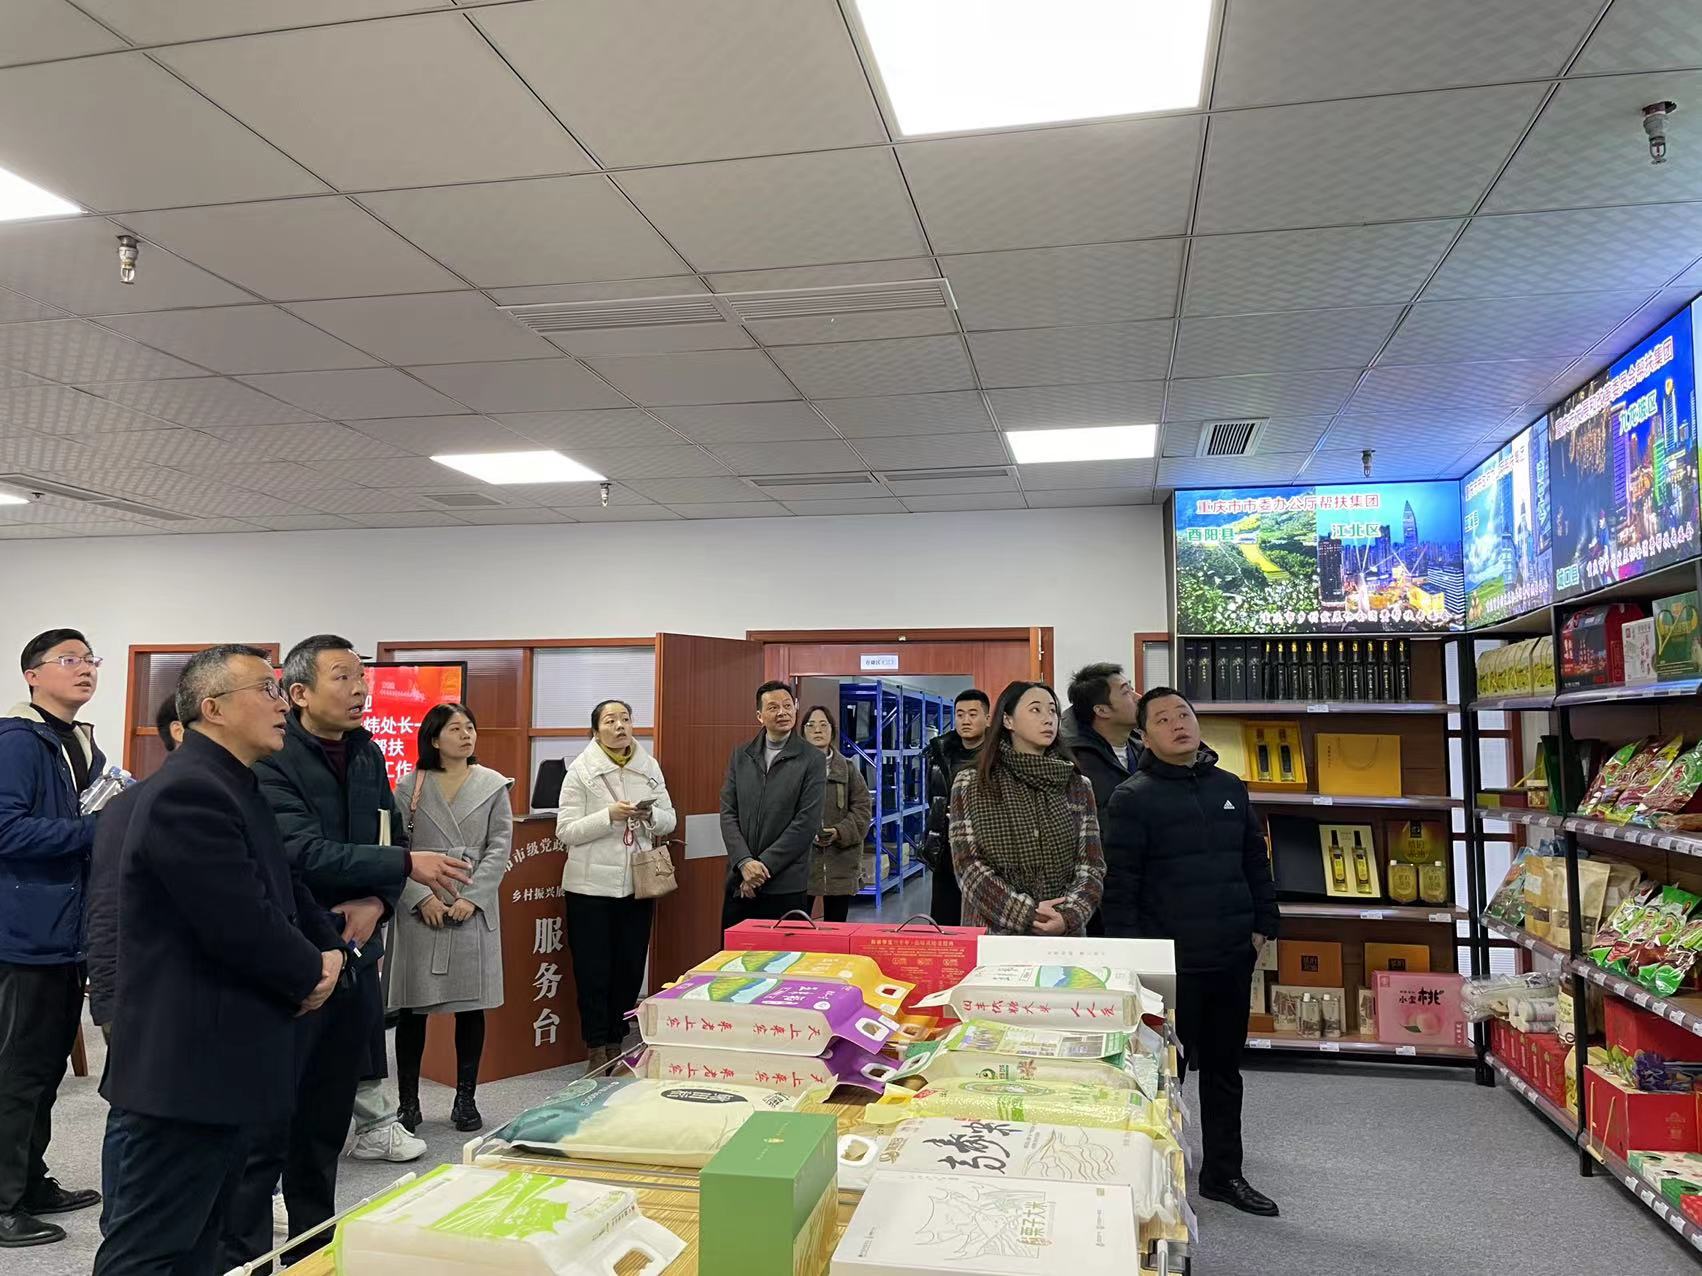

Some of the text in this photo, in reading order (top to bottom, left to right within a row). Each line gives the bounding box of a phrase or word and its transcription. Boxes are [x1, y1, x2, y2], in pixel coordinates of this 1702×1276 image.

[1197, 494, 1380, 515] 重庆市市委办公厅帮扶集团
[1187, 527, 1235, 542] 酉阳县
[1331, 523, 1381, 538] 江北区
[361, 716, 421, 734] 炜处长一
[532, 916, 563, 1047] 服务台
